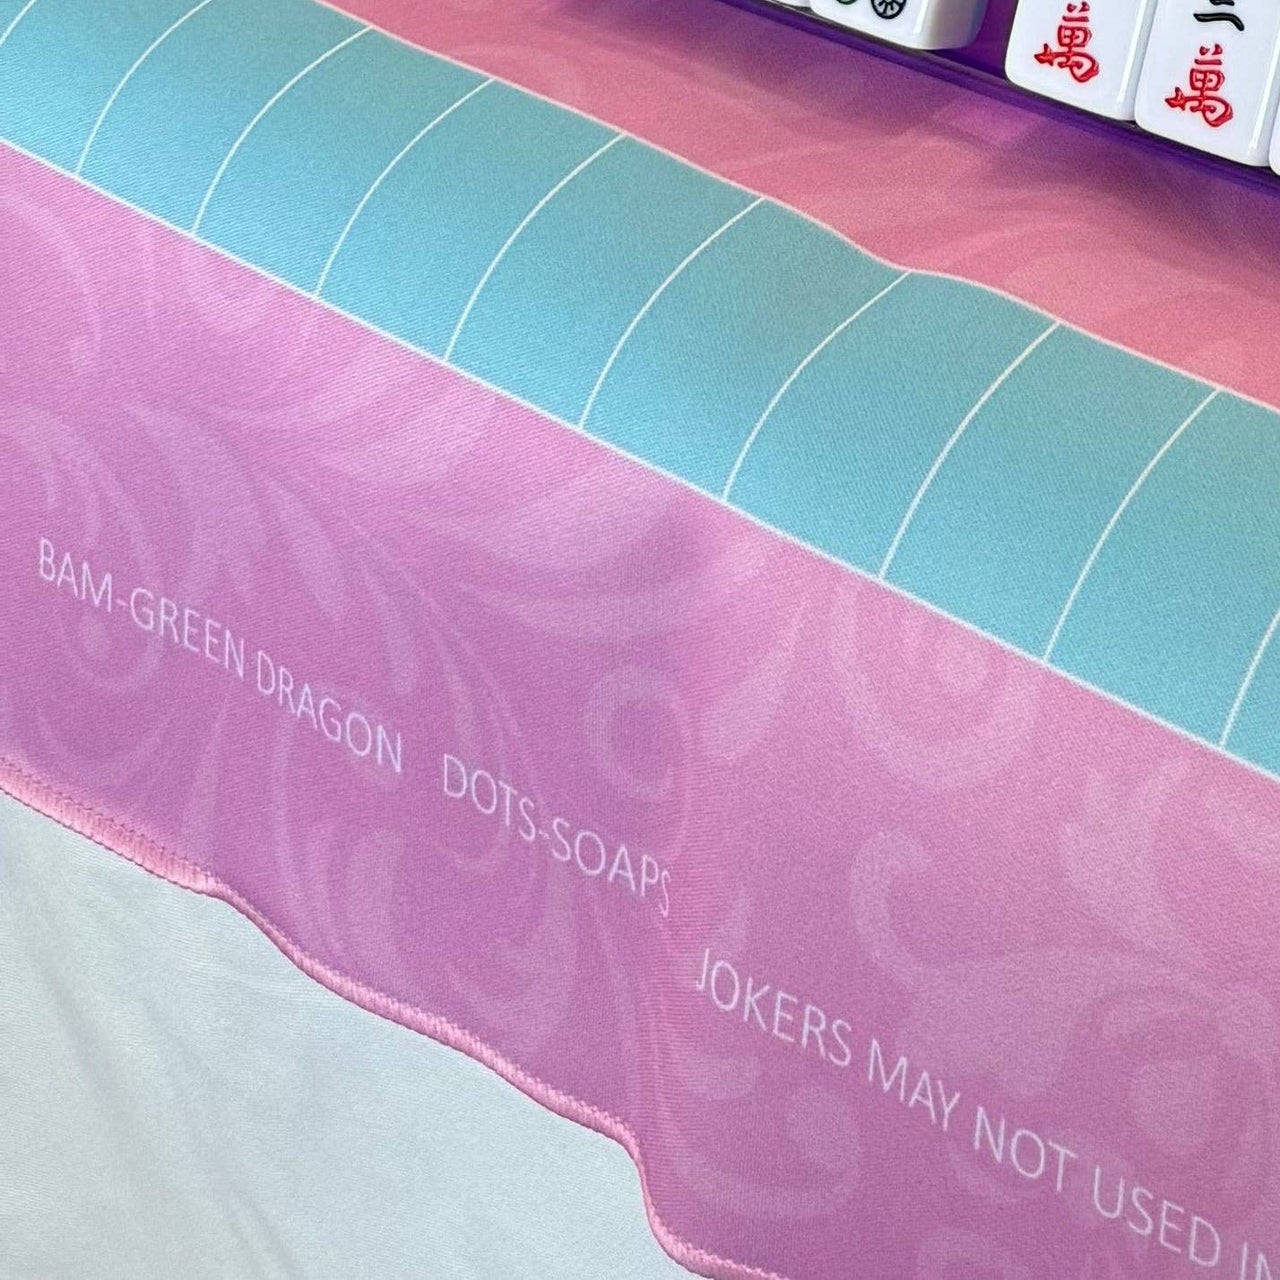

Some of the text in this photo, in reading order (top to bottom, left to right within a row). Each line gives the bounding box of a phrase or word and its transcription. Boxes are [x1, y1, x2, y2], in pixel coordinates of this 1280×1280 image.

[40, 537, 672, 919] BAM-GREEN DRAGON DOTS-SOAPS
[695, 947, 853, 1068] JOKERS
[867, 1038, 960, 1132] MAY
[972, 1106, 1078, 1194] NOT
[1092, 1167, 1222, 1269] USED
